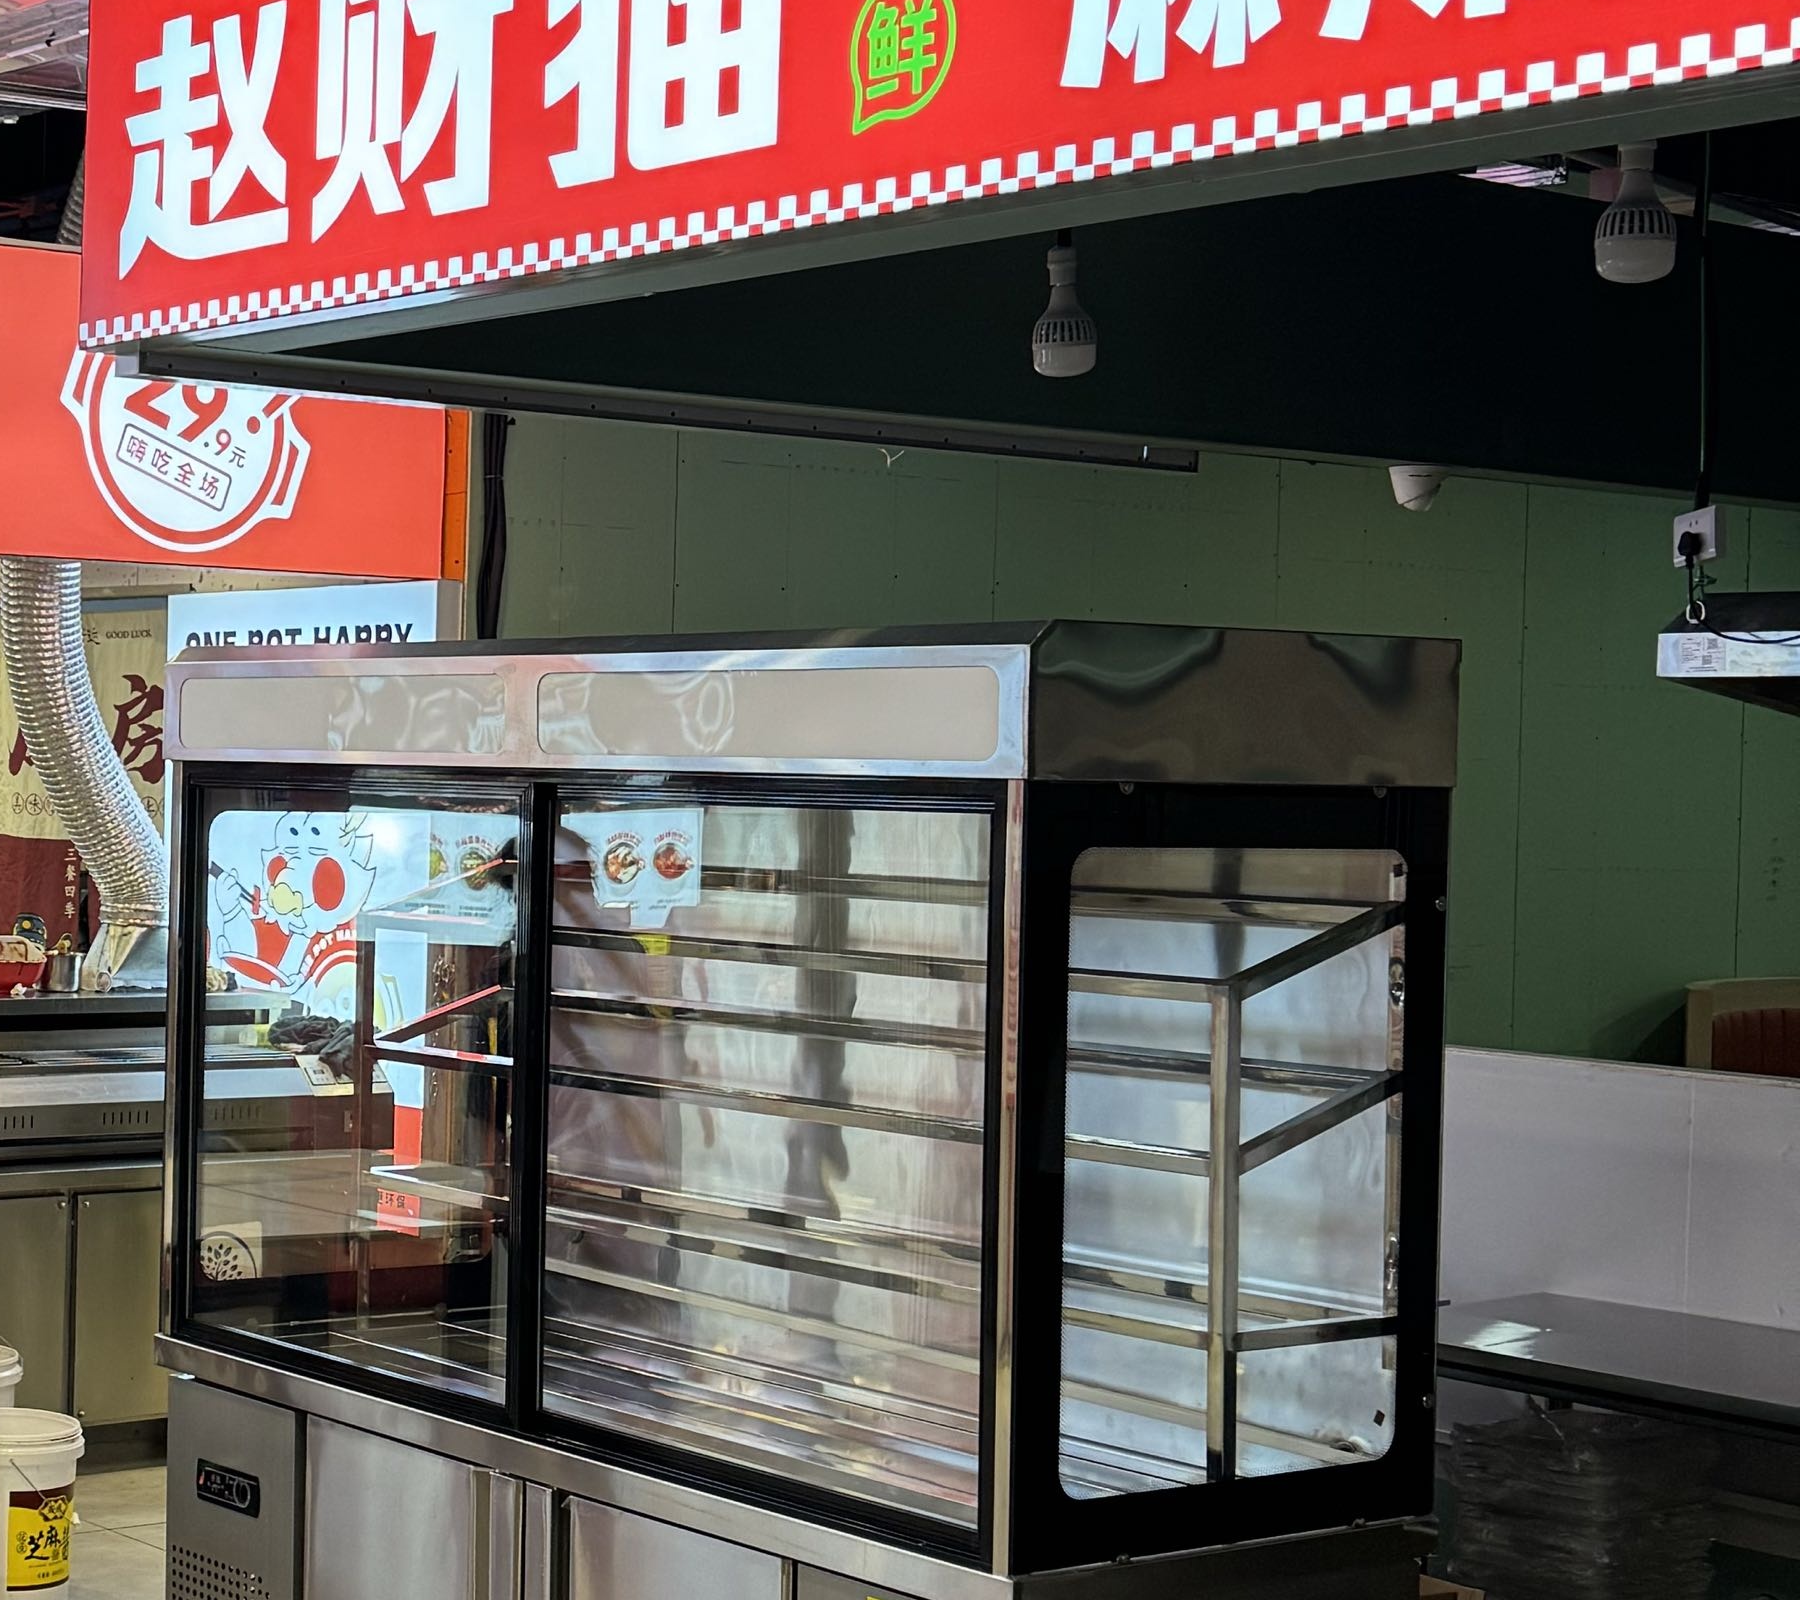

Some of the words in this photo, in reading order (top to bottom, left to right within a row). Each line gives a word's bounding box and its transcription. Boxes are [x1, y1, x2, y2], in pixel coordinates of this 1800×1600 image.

[126, 435, 219, 500] 嗨吃全场
[64, 848, 77, 919] 三餐四季
